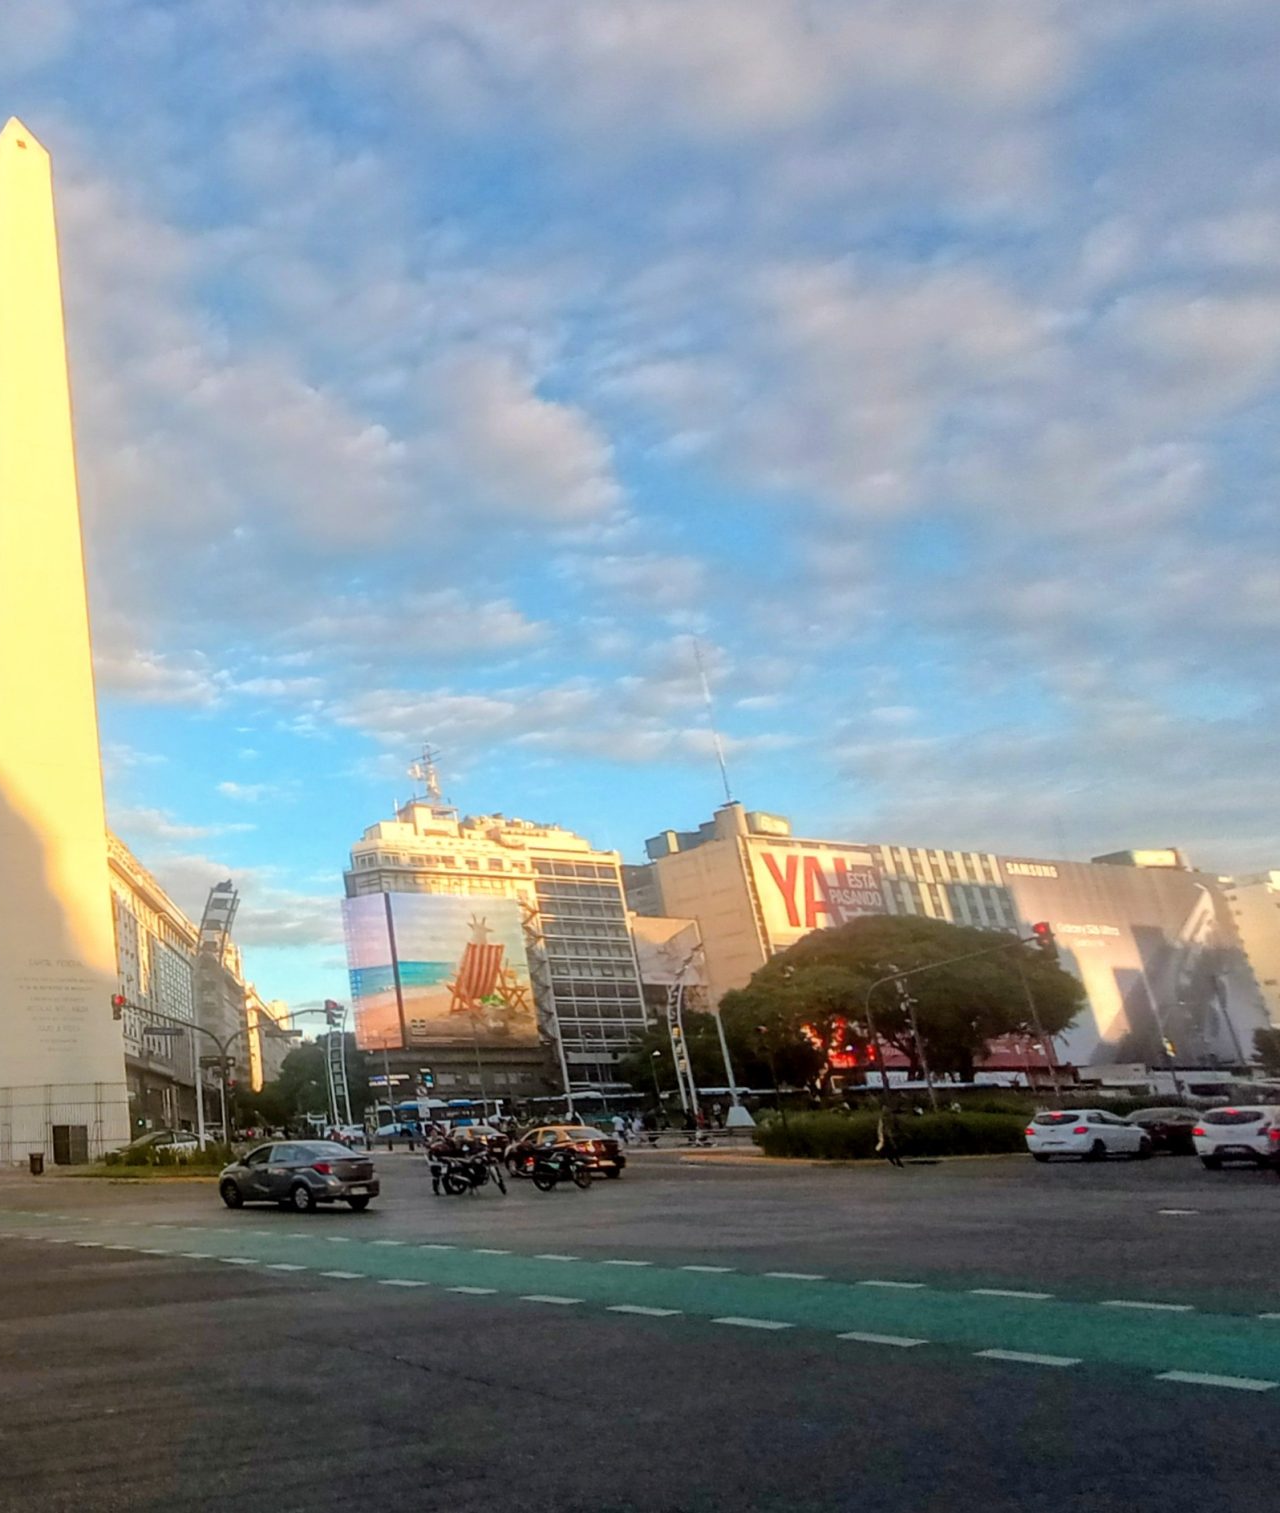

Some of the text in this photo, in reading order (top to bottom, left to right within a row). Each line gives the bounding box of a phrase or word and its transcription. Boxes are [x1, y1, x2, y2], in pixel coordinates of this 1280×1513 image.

[846, 869, 879, 890] ESTÁ
[1006, 862, 1058, 878] SAMSUNG
[828, 888, 882, 907] PASANDO
